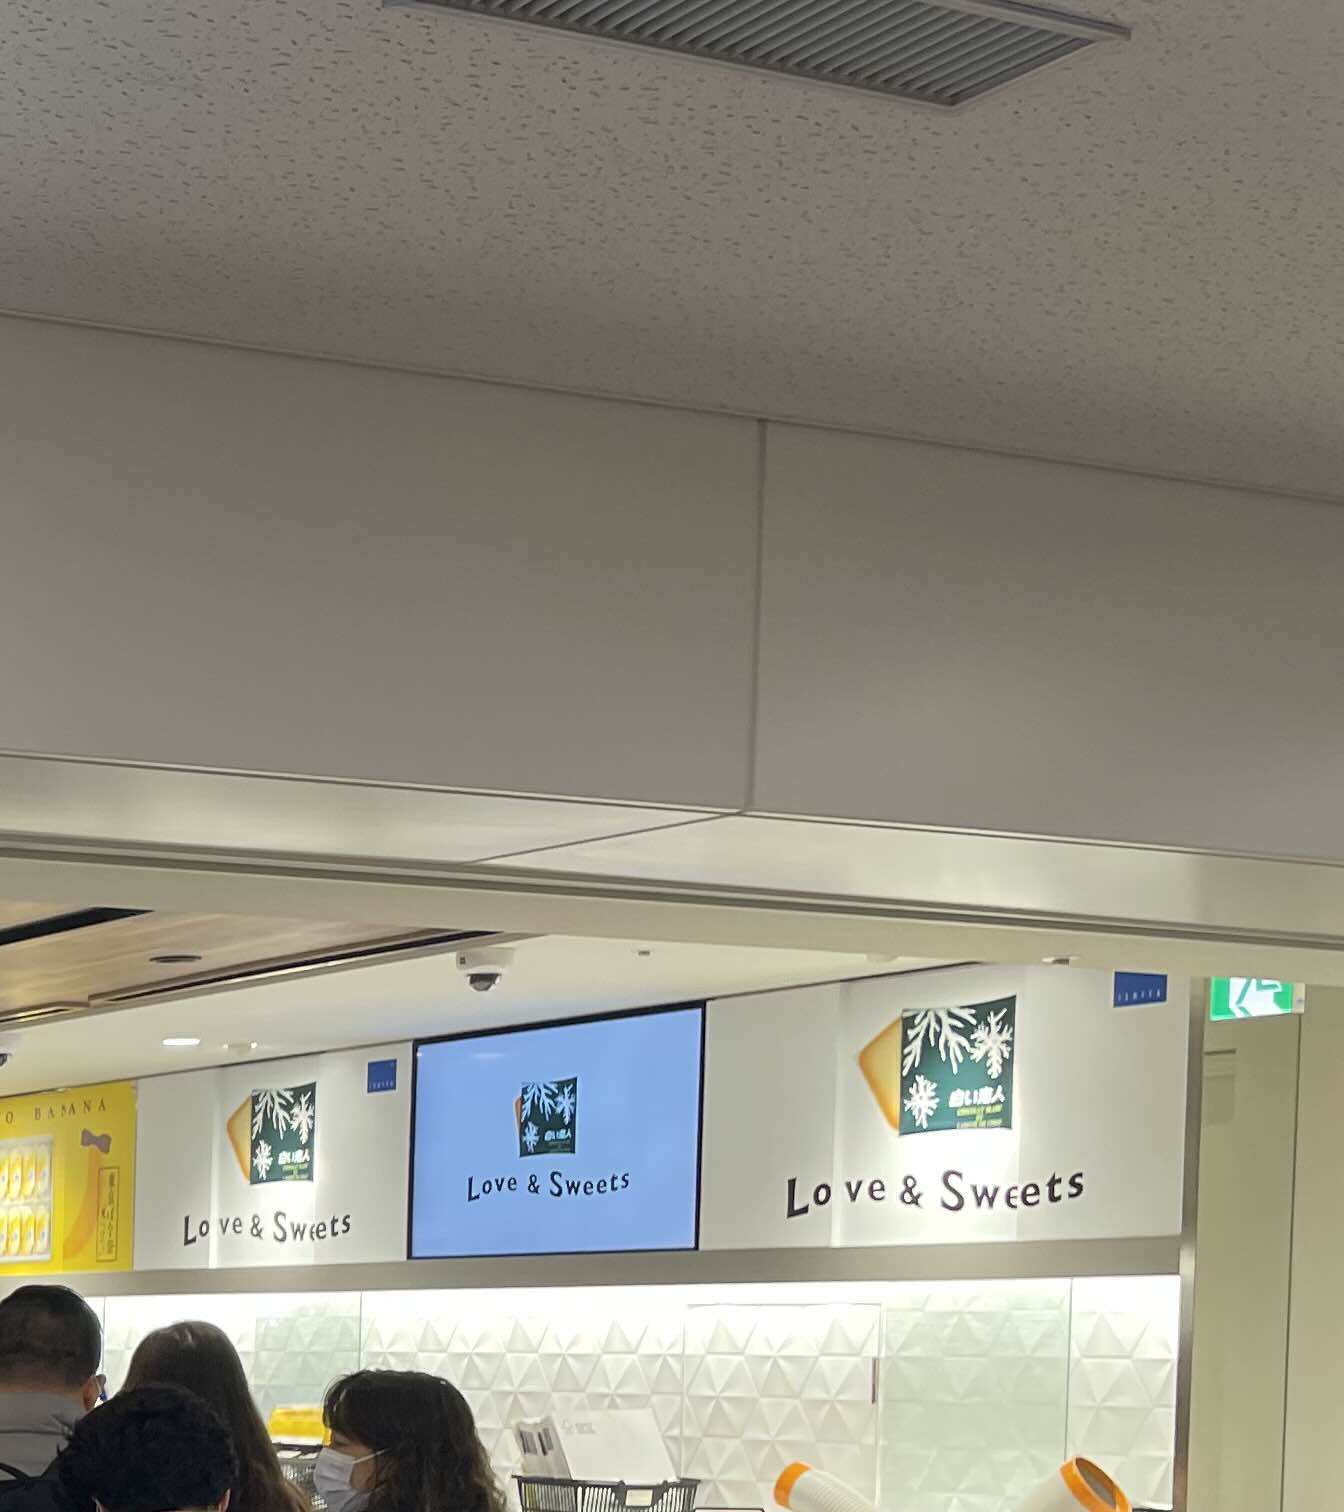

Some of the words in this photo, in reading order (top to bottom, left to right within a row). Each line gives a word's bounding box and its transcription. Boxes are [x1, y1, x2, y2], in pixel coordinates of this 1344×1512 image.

[467, 1176, 518, 1202] Love
[527, 1174, 540, 1195] &
[549, 1171, 630, 1198] Sweets
[786, 1177, 886, 1219] Love
[900, 1175, 923, 1208] &
[940, 1169, 1084, 1211] Sweets
[183, 1215, 243, 1246] Love
[250, 1214, 263, 1239] &
[273, 1210, 351, 1243] Sweets
